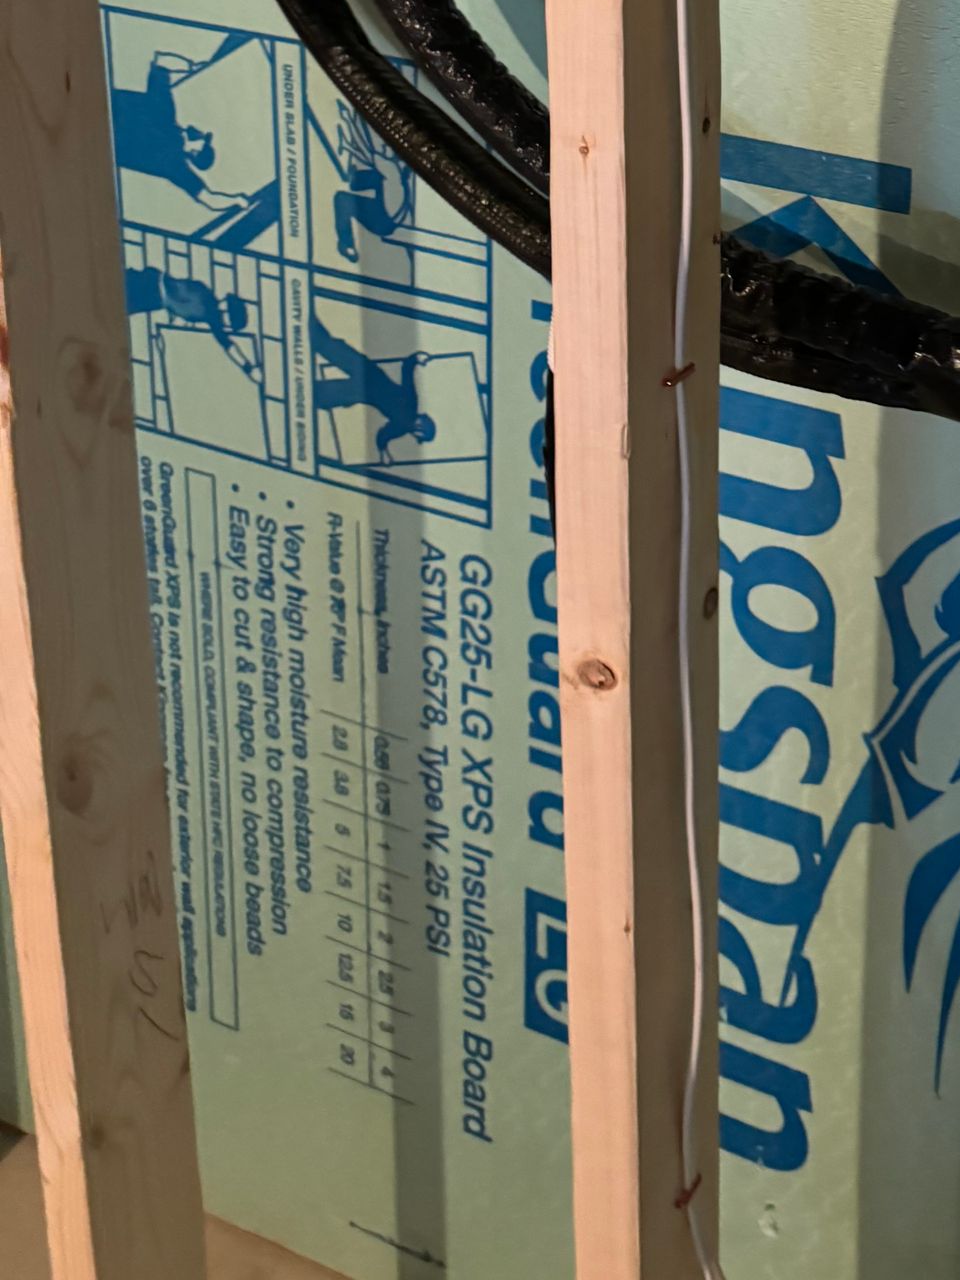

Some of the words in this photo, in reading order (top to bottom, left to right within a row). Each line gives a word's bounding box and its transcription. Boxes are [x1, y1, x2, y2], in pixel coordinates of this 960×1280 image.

[225, 505, 250, 570] Easy
[254, 515, 277, 602] Strong
[280, 525, 305, 580] Very
[232, 576, 254, 610] to
[282, 584, 308, 641] high
[420, 537, 447, 643] ASTM
[234, 608, 254, 650] cut
[460, 555, 493, 741] GG25-LG
[720, 132, 914, 1173] kngspan
[236, 656, 256, 678] &
[260, 608, 283, 740] resistance
[287, 648, 310, 760] moisture
[418, 643, 448, 732] C578,
[231, 681, 257, 762] shape,
[241, 771, 257, 804] no
[266, 747, 284, 772] to
[415, 743, 448, 814] Type
[462, 748, 494, 834] XPS
[242, 809, 262, 876] loose
[262, 779, 291, 935] compression
[293, 766, 314, 893] resistance
[419, 817, 449, 856] IV,
[424, 857, 449, 899] 25
[245, 882, 266, 956] beads
[424, 901, 450, 960] PSI
[462, 842, 494, 1022] Insulation
[463, 1030, 497, 1143] Board
